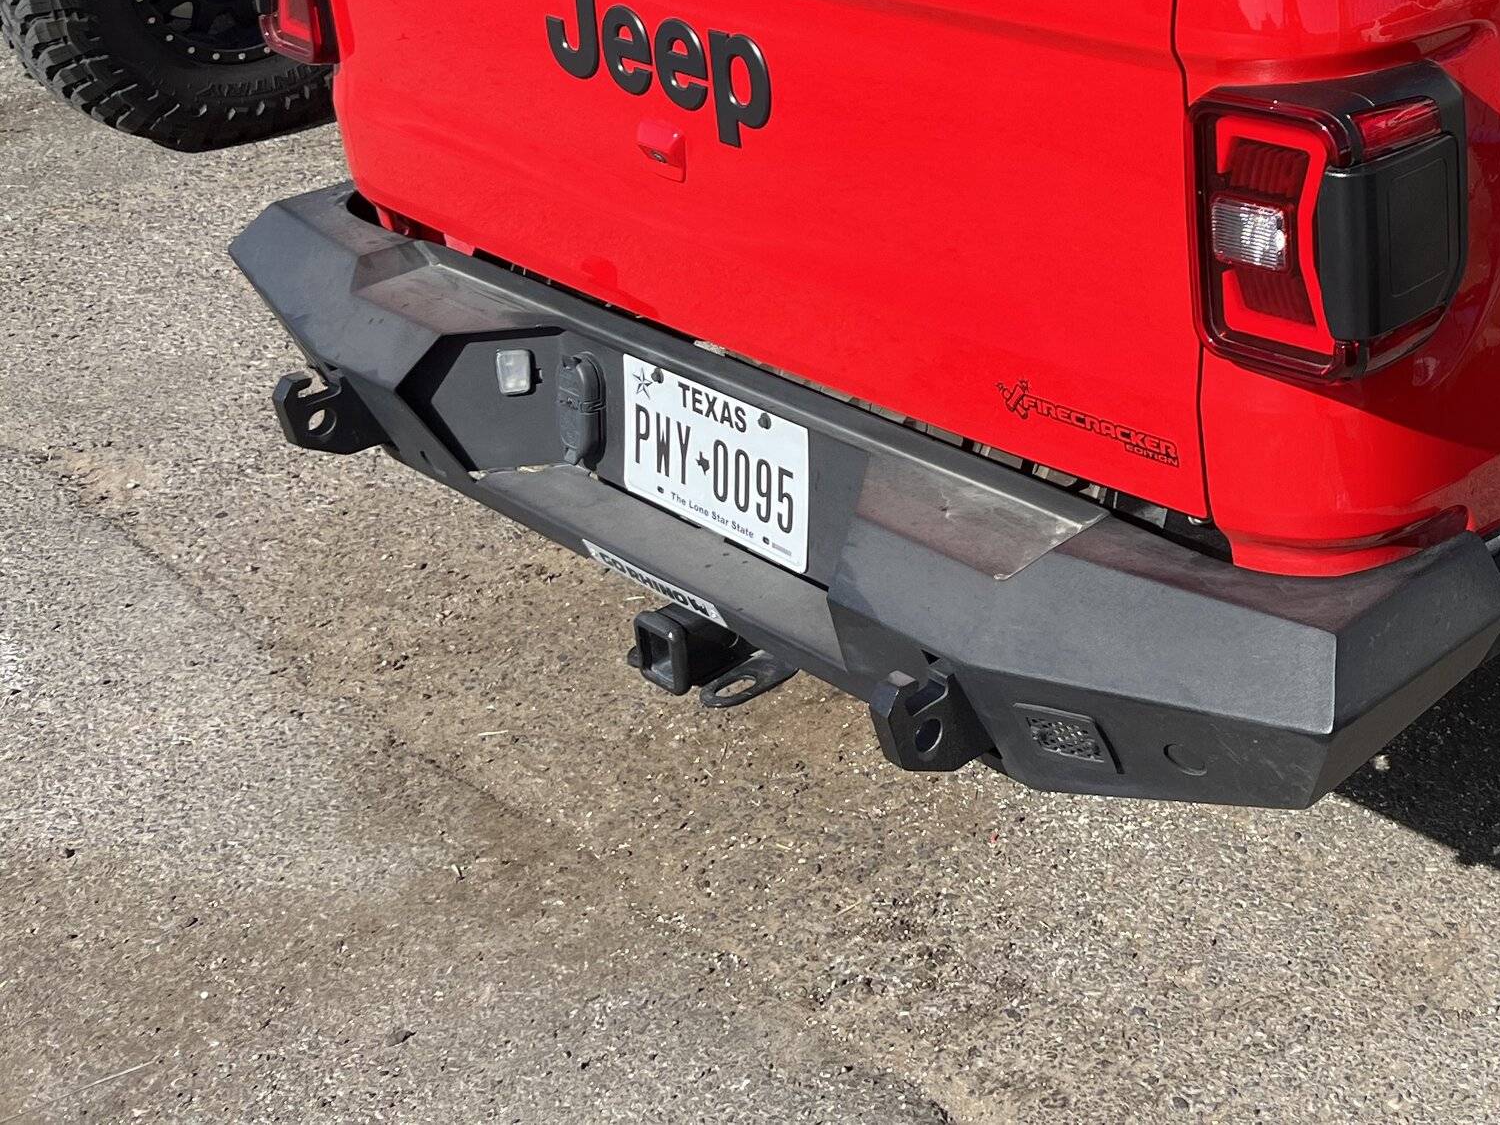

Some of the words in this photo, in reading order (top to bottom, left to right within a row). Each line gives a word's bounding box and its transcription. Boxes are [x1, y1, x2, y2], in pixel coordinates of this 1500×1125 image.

[677, 382, 748, 433] TEXAS
[1020, 393, 1178, 458] FIRECRACKER
[1125, 442, 1180, 468] EDITION
[671, 492, 687, 506] The
[688, 500, 709, 516] Lone
[711, 511, 729, 524] Star
[731, 521, 754, 538] State
